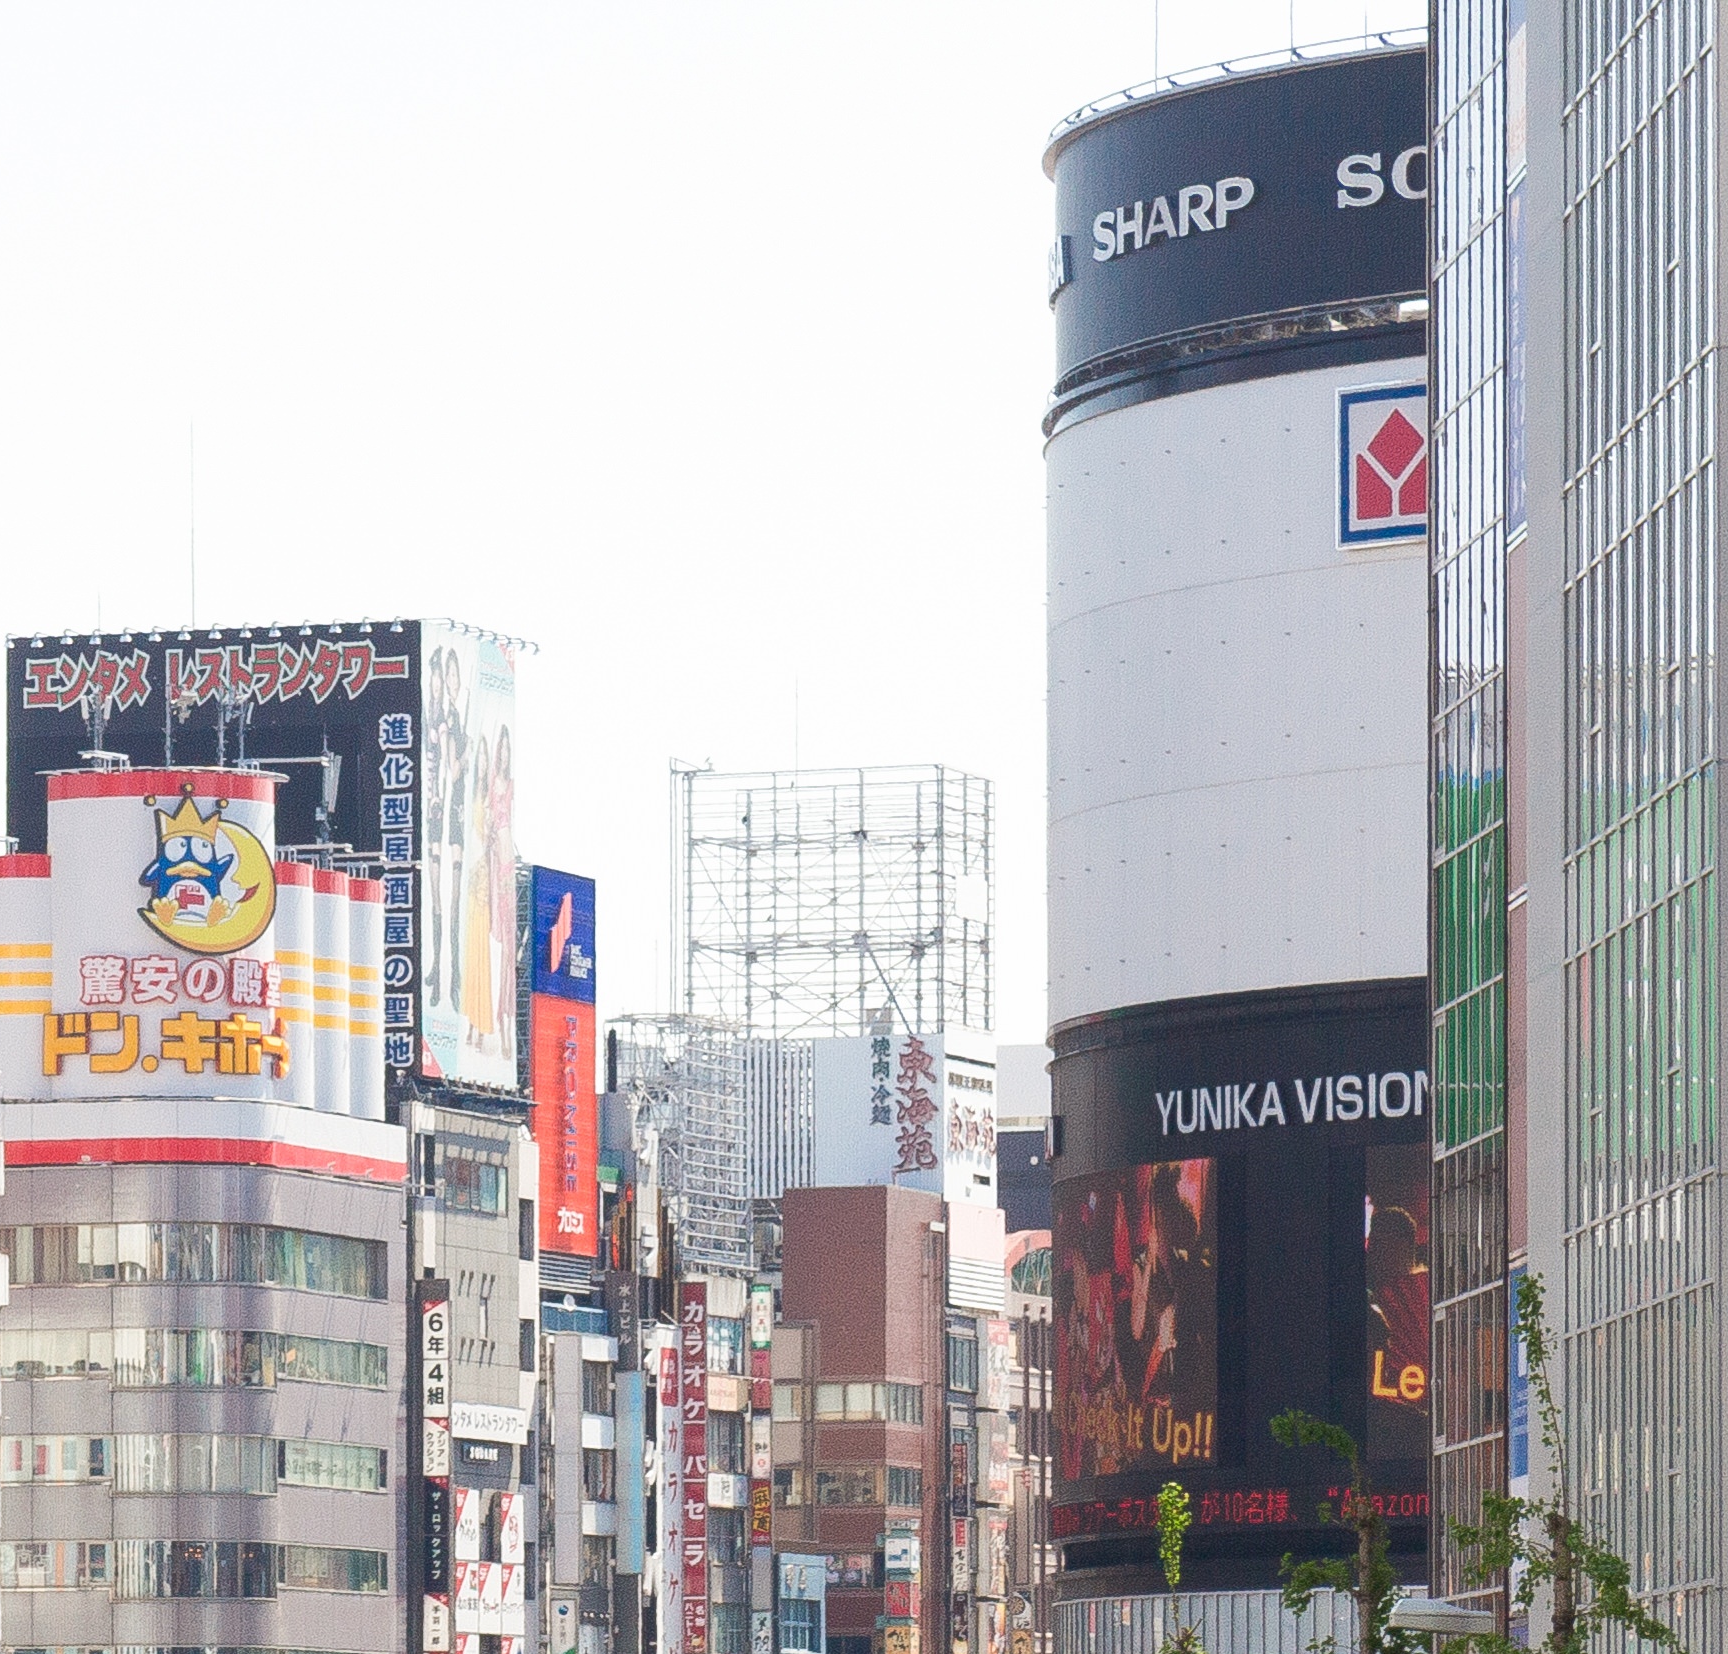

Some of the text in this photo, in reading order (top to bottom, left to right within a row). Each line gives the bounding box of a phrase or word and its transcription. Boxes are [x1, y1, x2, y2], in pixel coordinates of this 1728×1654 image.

[1093, 177, 1255, 262] SHARP
[24, 653, 150, 710] エンタメ
[167, 638, 410, 702] レストランタワー
[379, 714, 413, 1069] 進化型居酒屋の聖地
[80, 955, 283, 1009] 驚安の殿堂
[1155, 1079, 1286, 1136] YUNIKA
[427, 1312, 444, 1405] 6年4組
[454, 1410, 473, 1427] ンタメ
[684, 1301, 705, 1567] カラオケ パセラ
[1152, 1407, 1212, 1463] Up!!
[668, 1422, 680, 1604] カラオケ
